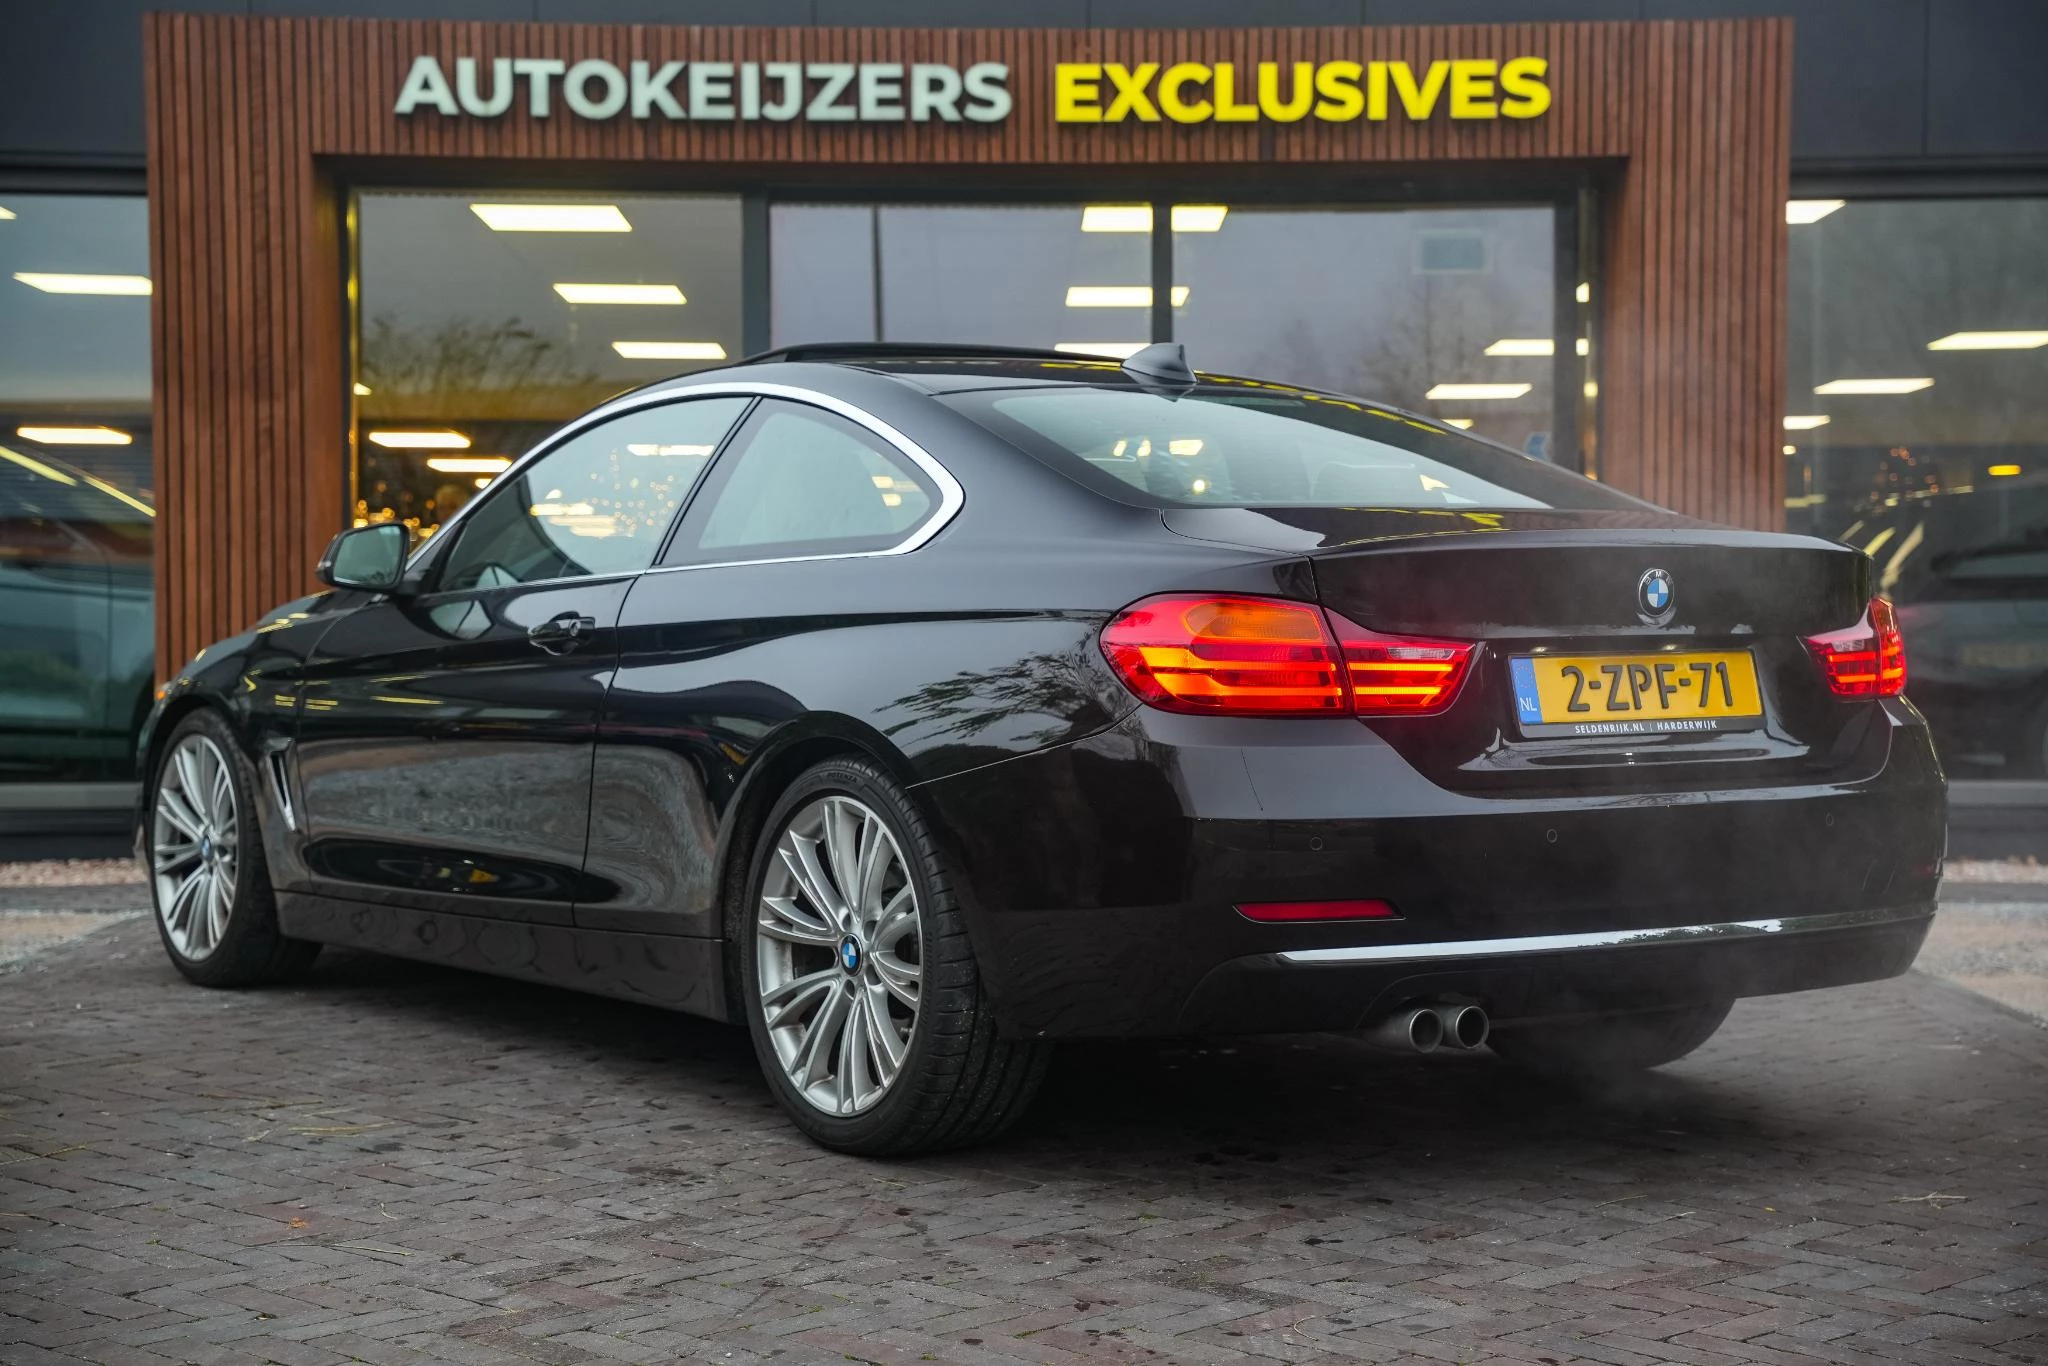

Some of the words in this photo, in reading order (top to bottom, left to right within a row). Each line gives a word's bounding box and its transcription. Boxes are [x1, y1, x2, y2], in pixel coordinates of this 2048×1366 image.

[394, 55, 1013, 124] AUTOKEIJZERS
[1055, 56, 1552, 123] EXCLUSIVES
[1561, 661, 1733, 712] 2-ZPF-71
[1519, 697, 1538, 712] NL
[1575, 722, 1645, 734] SELDENRIJK.NL
[1656, 720, 1717, 732] HARDERWIJK
